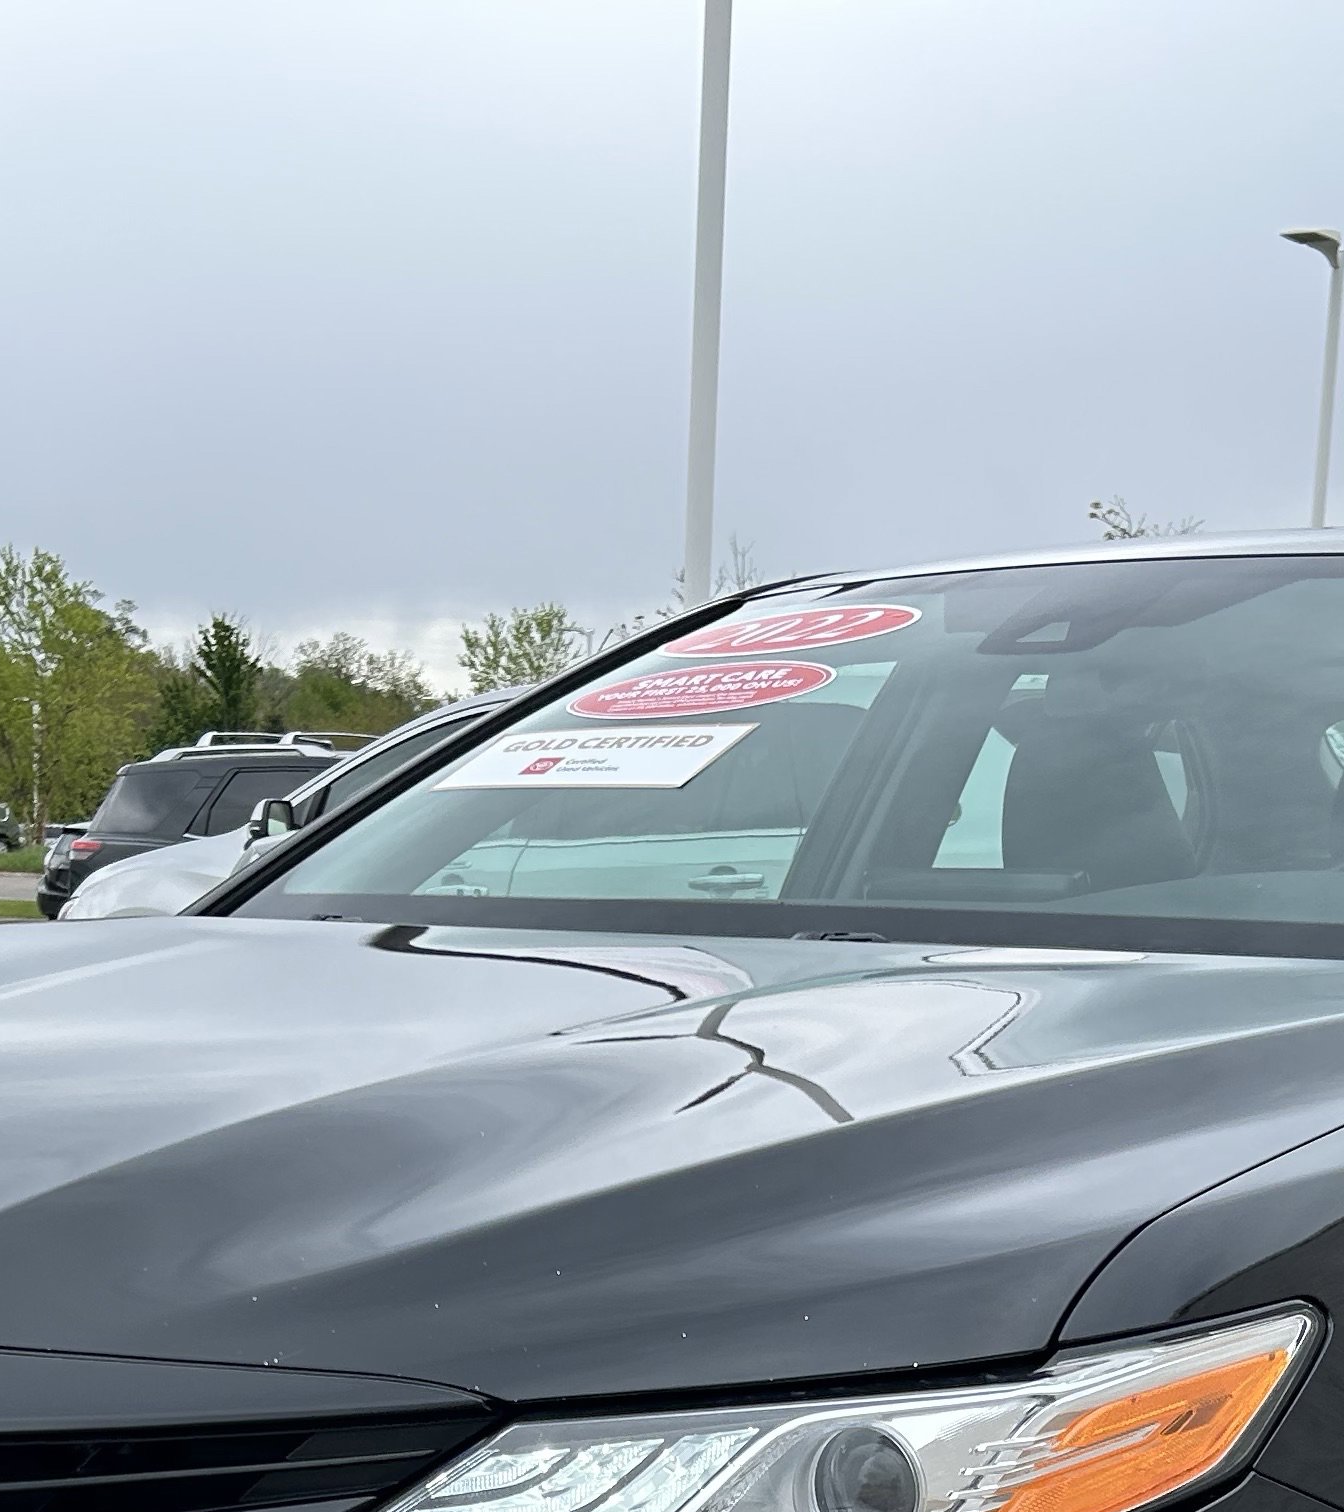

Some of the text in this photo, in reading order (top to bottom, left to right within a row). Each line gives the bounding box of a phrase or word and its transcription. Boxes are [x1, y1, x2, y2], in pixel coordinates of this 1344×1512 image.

[684, 610, 885, 652] 2022
[598, 689, 644, 702] YOUR
[641, 686, 688, 700] FIRST
[741, 680, 772, 692] ON
[767, 677, 804, 689] US!
[632, 667, 793, 691] SMART CARE
[503, 734, 715, 753] GOLD CERTIFIED
[564, 757, 609, 766] Certified
